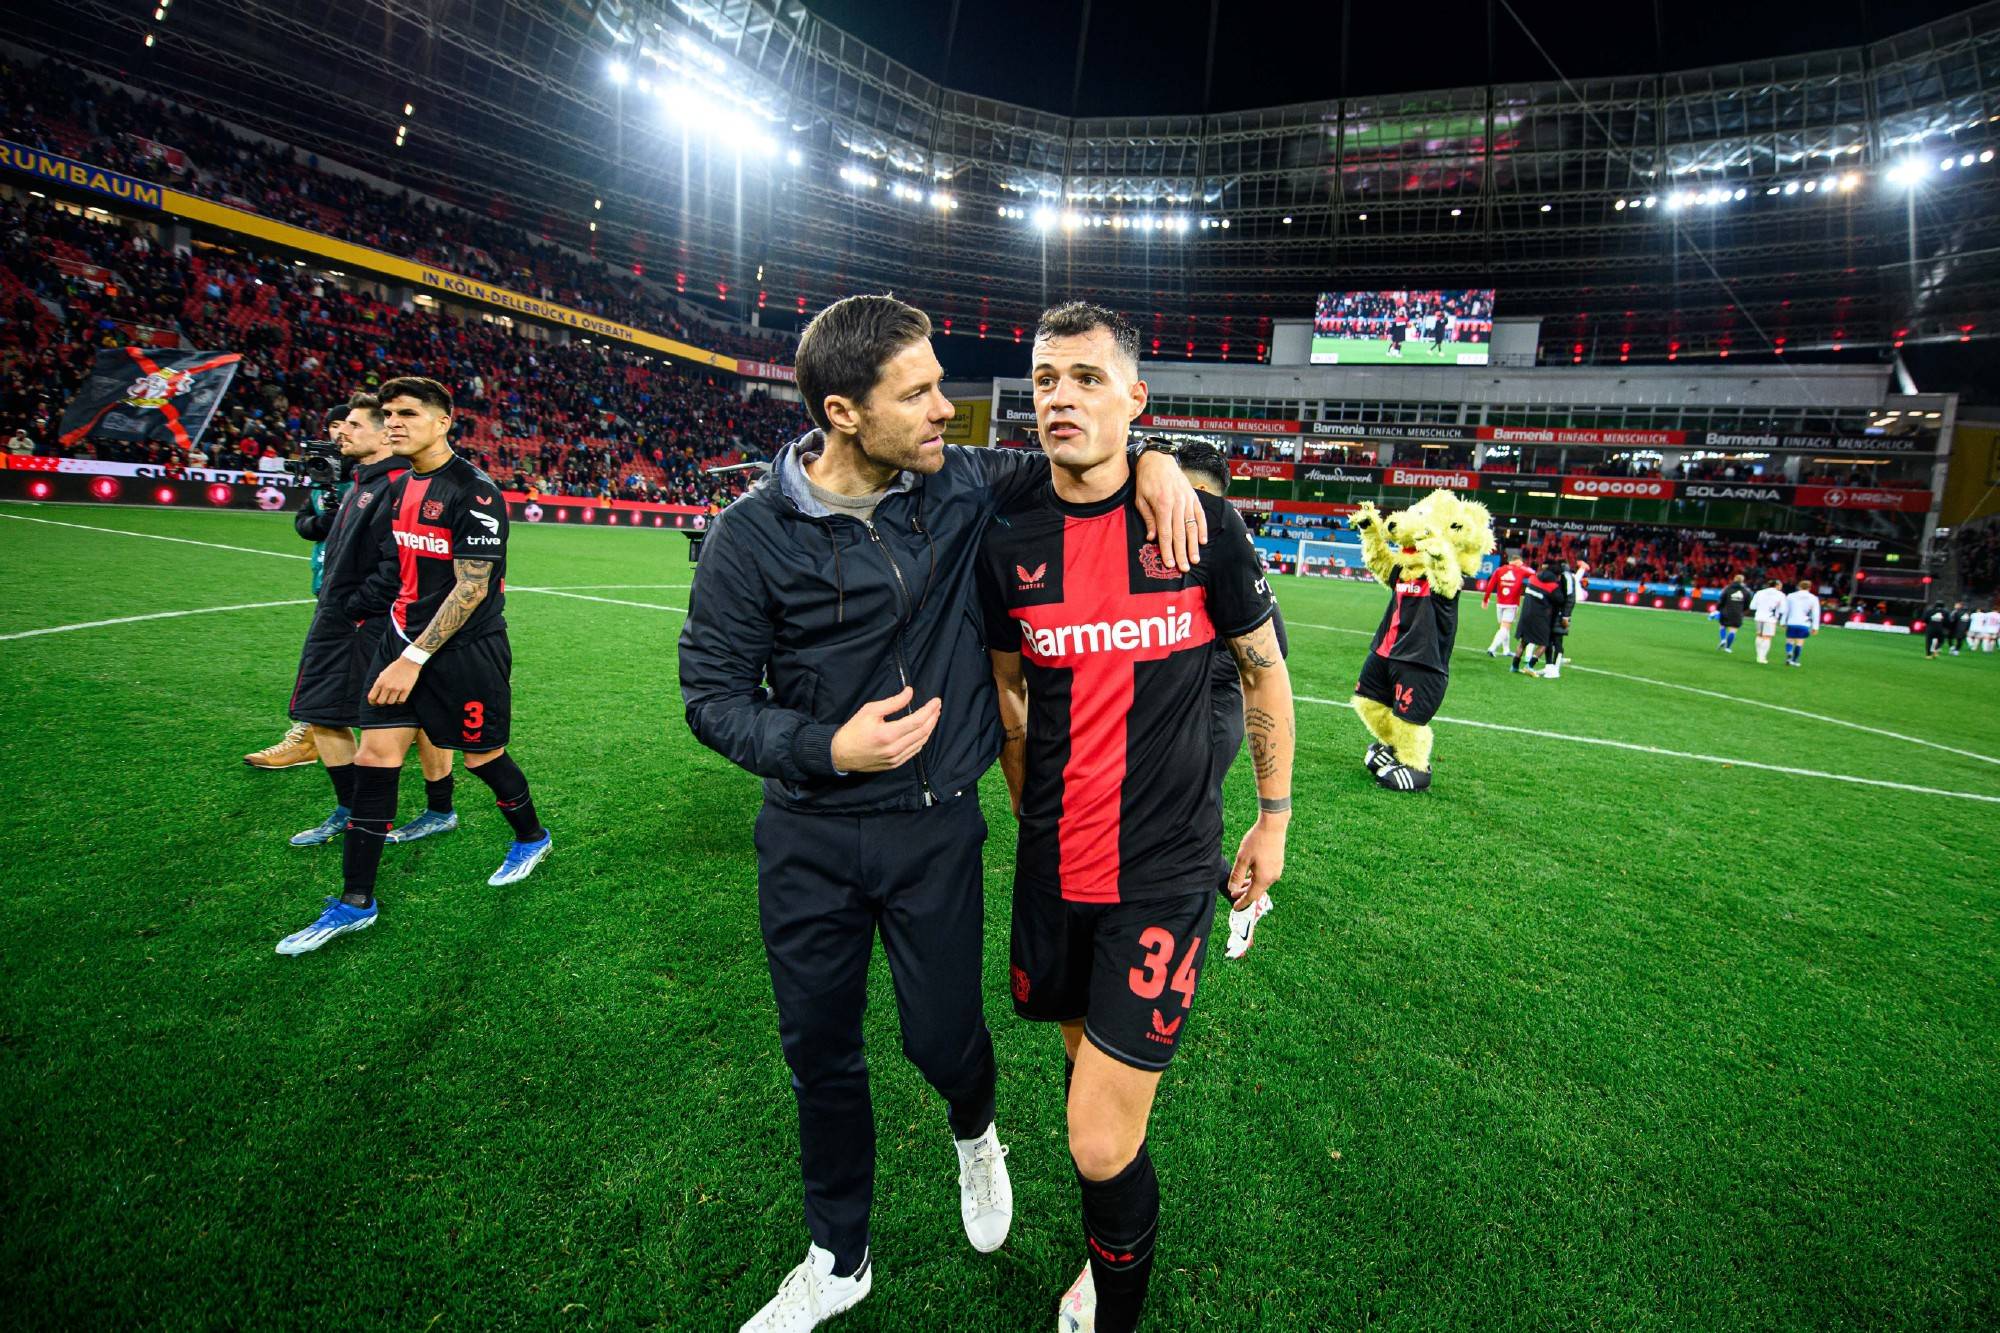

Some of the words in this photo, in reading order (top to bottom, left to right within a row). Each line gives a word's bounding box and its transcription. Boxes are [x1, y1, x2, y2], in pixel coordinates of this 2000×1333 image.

[0, 145, 158, 206] RUMBAUM
[422, 271, 439, 286] IN
[444, 277, 565, 321] KÖLN-DELLBRÜCK
[569, 314, 577, 325] &
[581, 316, 633, 340] OVERATH
[1152, 415, 1200, 429] Barmenia
[1313, 422, 1365, 435] Barmenia
[1493, 428, 1554, 441] Barmenia
[1705, 433, 1778, 447] Barmenia
[1304, 467, 1373, 483] Alexanderwerk
[1393, 470, 1469, 488] Barmenia
[1685, 485, 1780, 500] SOLARNIA
[1531, 518, 1584, 532] Probe-Abo
[1019, 605, 1193, 657] Barmenia
[463, 700, 484, 728] 3
[1128, 924, 1201, 1009] 34
